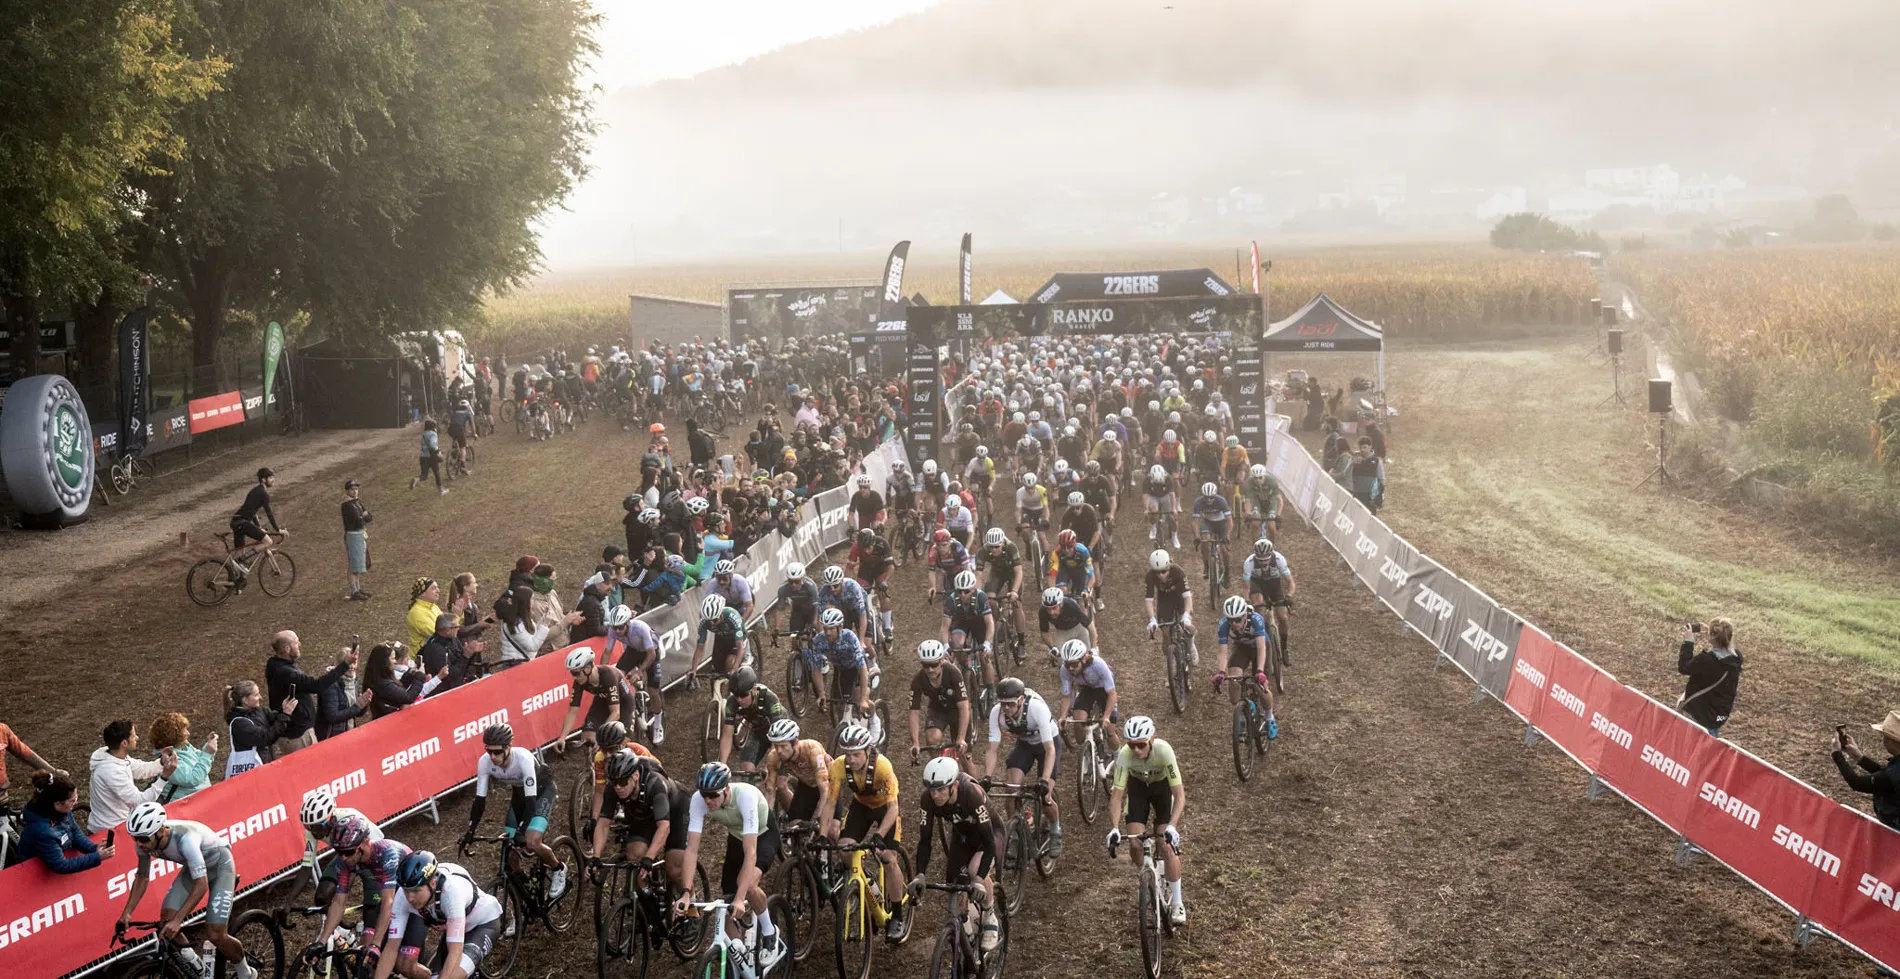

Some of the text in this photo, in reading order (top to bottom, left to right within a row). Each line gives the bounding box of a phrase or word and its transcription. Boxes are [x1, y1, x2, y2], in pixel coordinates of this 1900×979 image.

[885, 254, 904, 303] 226ERS
[1037, 282, 1060, 304] 226ERS
[1103, 275, 1159, 295] 226ERS
[1204, 277, 1229, 296] 226ERS
[876, 320, 907, 331] 226E
[1053, 308, 1114, 323] RANXO
[132, 329, 140, 415] TCHINSON
[245, 395, 263, 410] ZIPP
[101, 432, 117, 449] RIDE
[1356, 530, 1378, 560] ZIPP
[1380, 555, 1408, 588] ZIPP
[1414, 583, 1454, 620] ZIPP
[659, 621, 689, 660] PP
[1460, 618, 1508, 662] ZIPP
[1515, 658, 1546, 689] SRAM
[521, 683, 570, 716] SRAM
[609, 685, 620, 702] PAS
[1550, 683, 1586, 718] SRAM
[453, 708, 509, 745] SRAM
[1590, 711, 1633, 750] SRAM
[381, 736, 441, 776] SRAM
[1640, 744, 1690, 788] SRAM
[975, 804, 992, 824] PAS
[1700, 781, 1761, 830] SRAM
[1772, 824, 1841, 877] SRAM
[219, 890, 233, 919] LLUM
